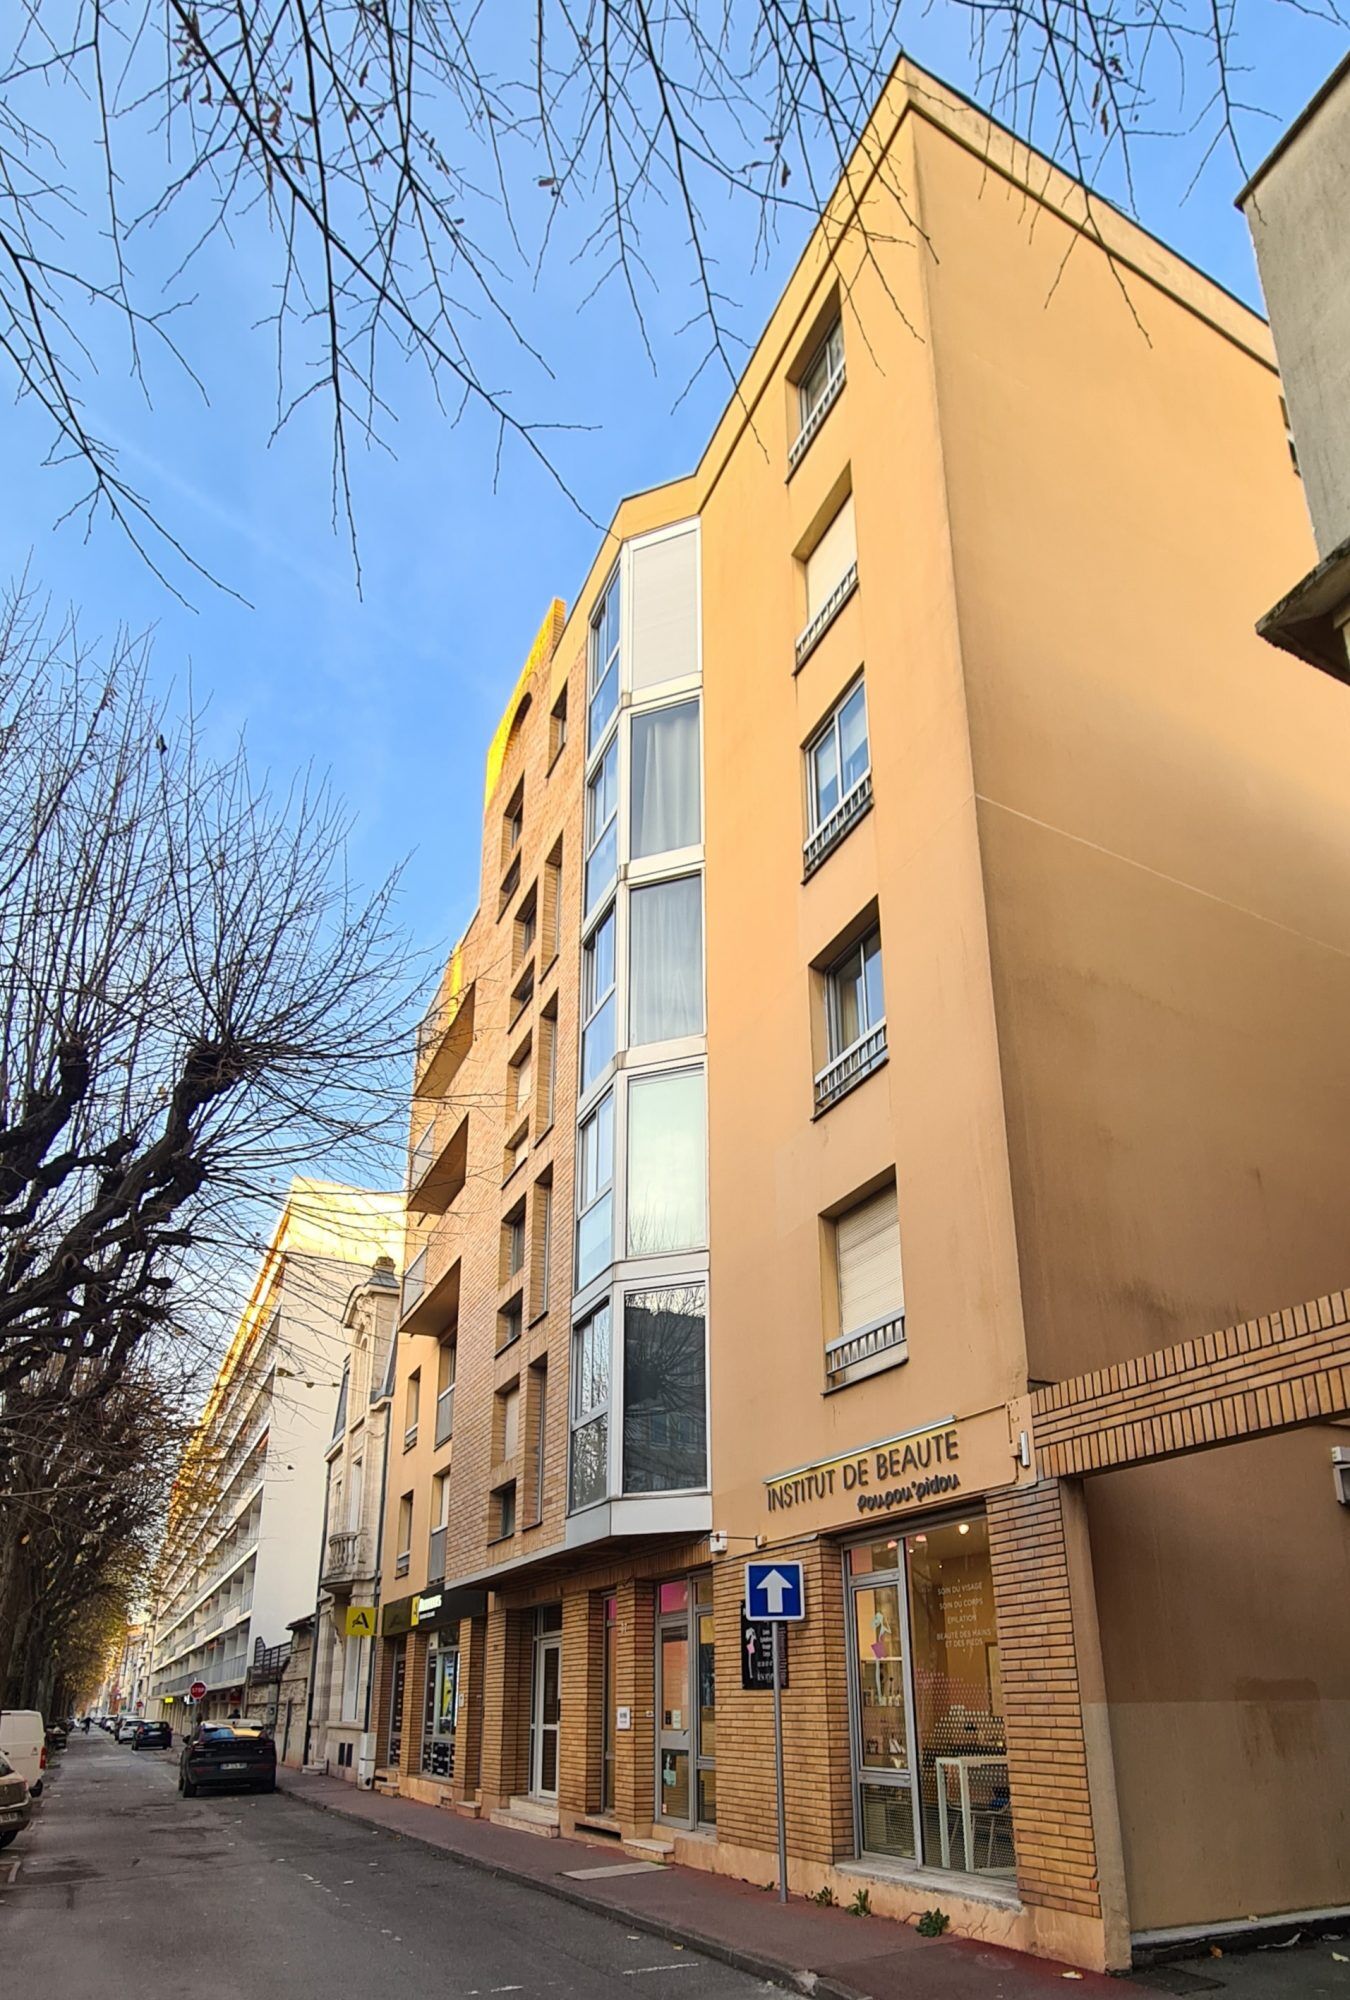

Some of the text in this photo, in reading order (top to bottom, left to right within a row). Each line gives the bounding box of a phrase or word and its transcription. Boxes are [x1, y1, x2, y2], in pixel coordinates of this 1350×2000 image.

[767, 1429, 959, 1512] INSTITUT DE BEAUTE
[937, 1581, 983, 1596] SOIN DU VISAGE
[939, 1597, 984, 1610] SOIN DU CORPS
[191, 1686, 205, 1694] STOP
